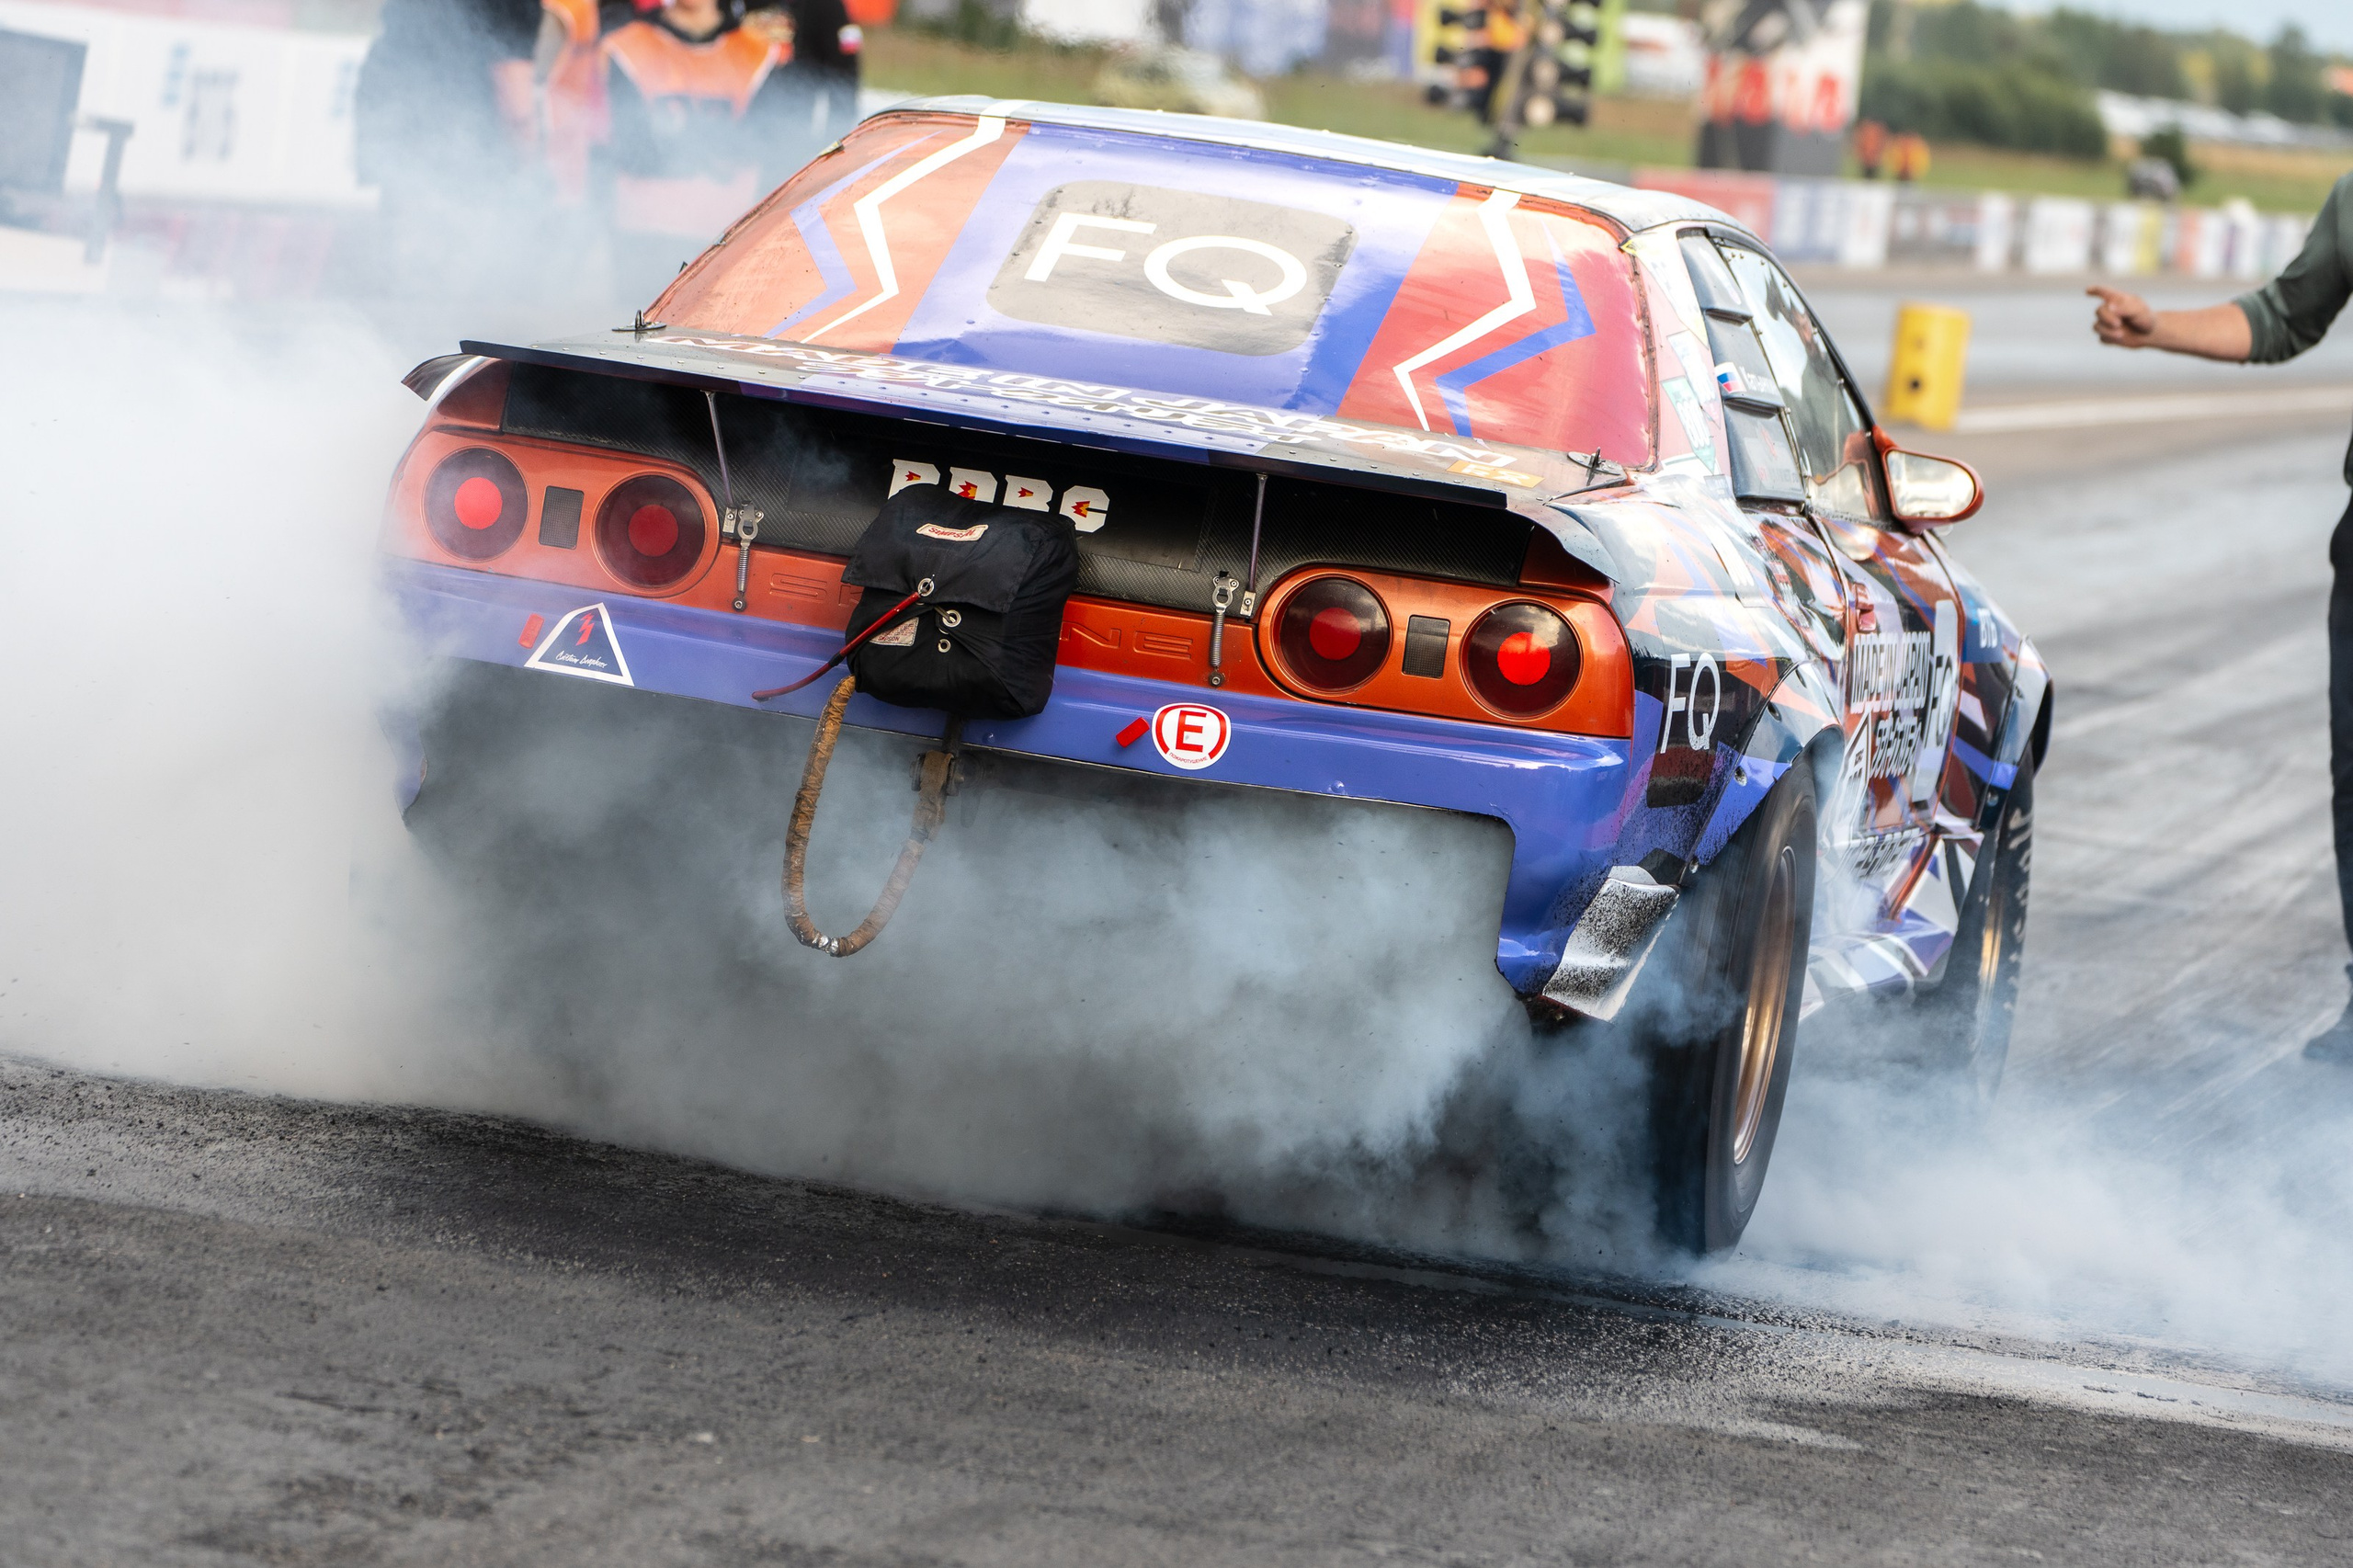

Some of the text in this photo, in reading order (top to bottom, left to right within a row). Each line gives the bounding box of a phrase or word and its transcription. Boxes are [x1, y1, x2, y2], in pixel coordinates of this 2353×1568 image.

[1024, 212, 1307, 315] FQ
[646, 336, 1518, 467] MADE IN JAPAN
[1175, 710, 1208, 753] E
[1660, 652, 1721, 754] FQ
